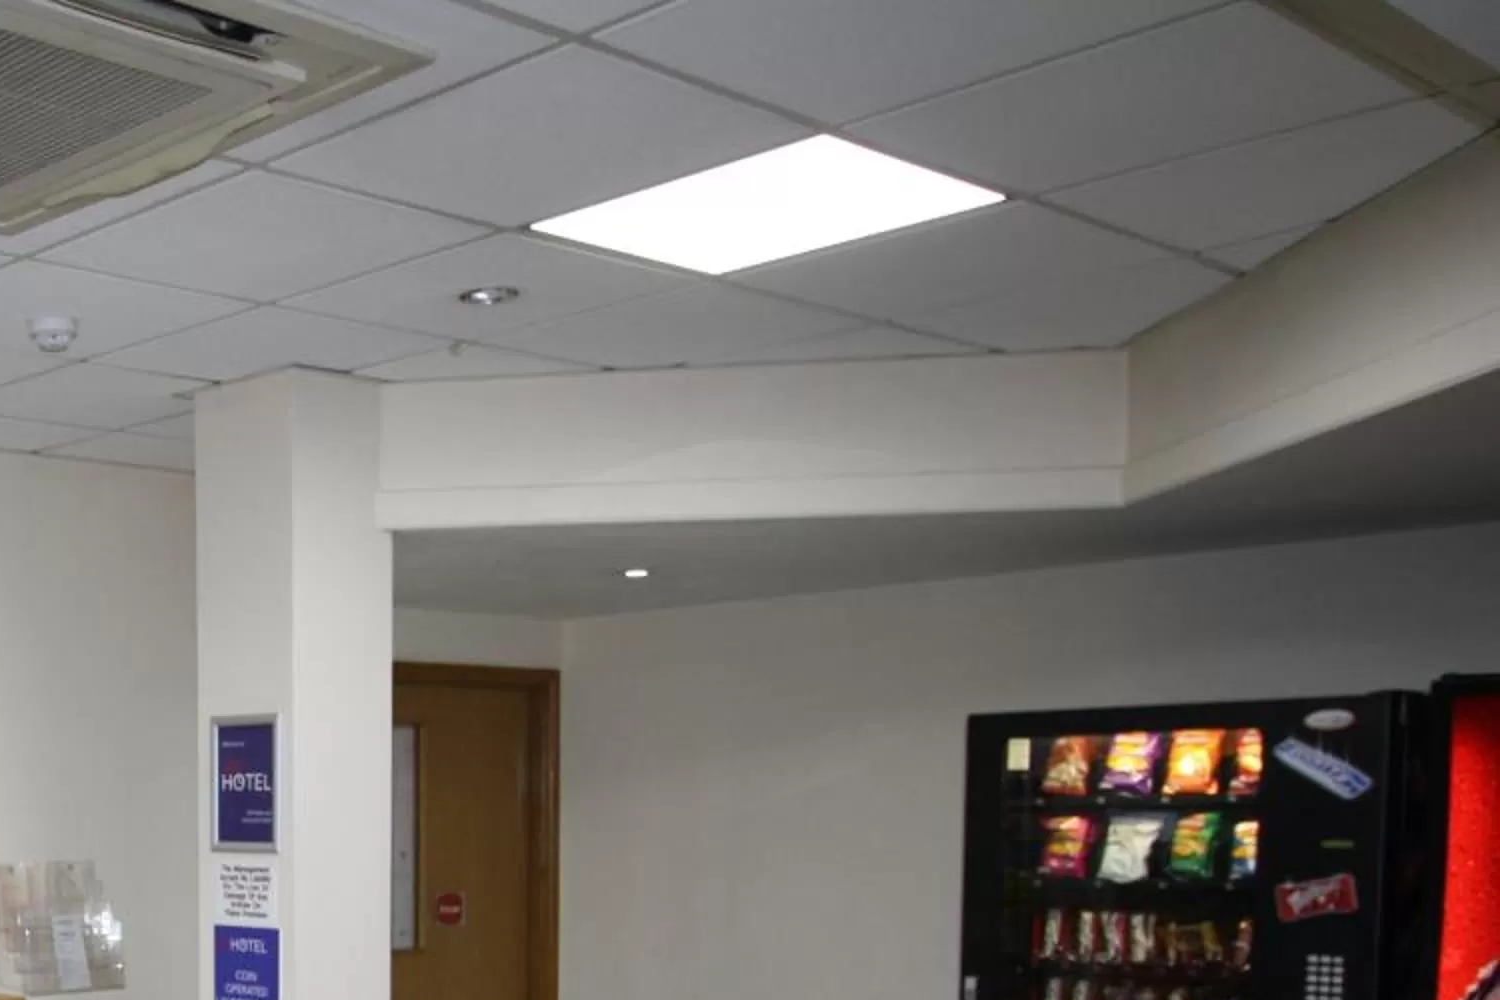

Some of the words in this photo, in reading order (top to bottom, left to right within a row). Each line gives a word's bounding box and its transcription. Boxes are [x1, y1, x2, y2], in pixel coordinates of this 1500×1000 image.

[221, 772, 272, 793] HOTEL
[230, 938, 268, 954] HOTEL
[234, 969, 258, 982] COIN
[225, 983, 269, 998] OPERATED
